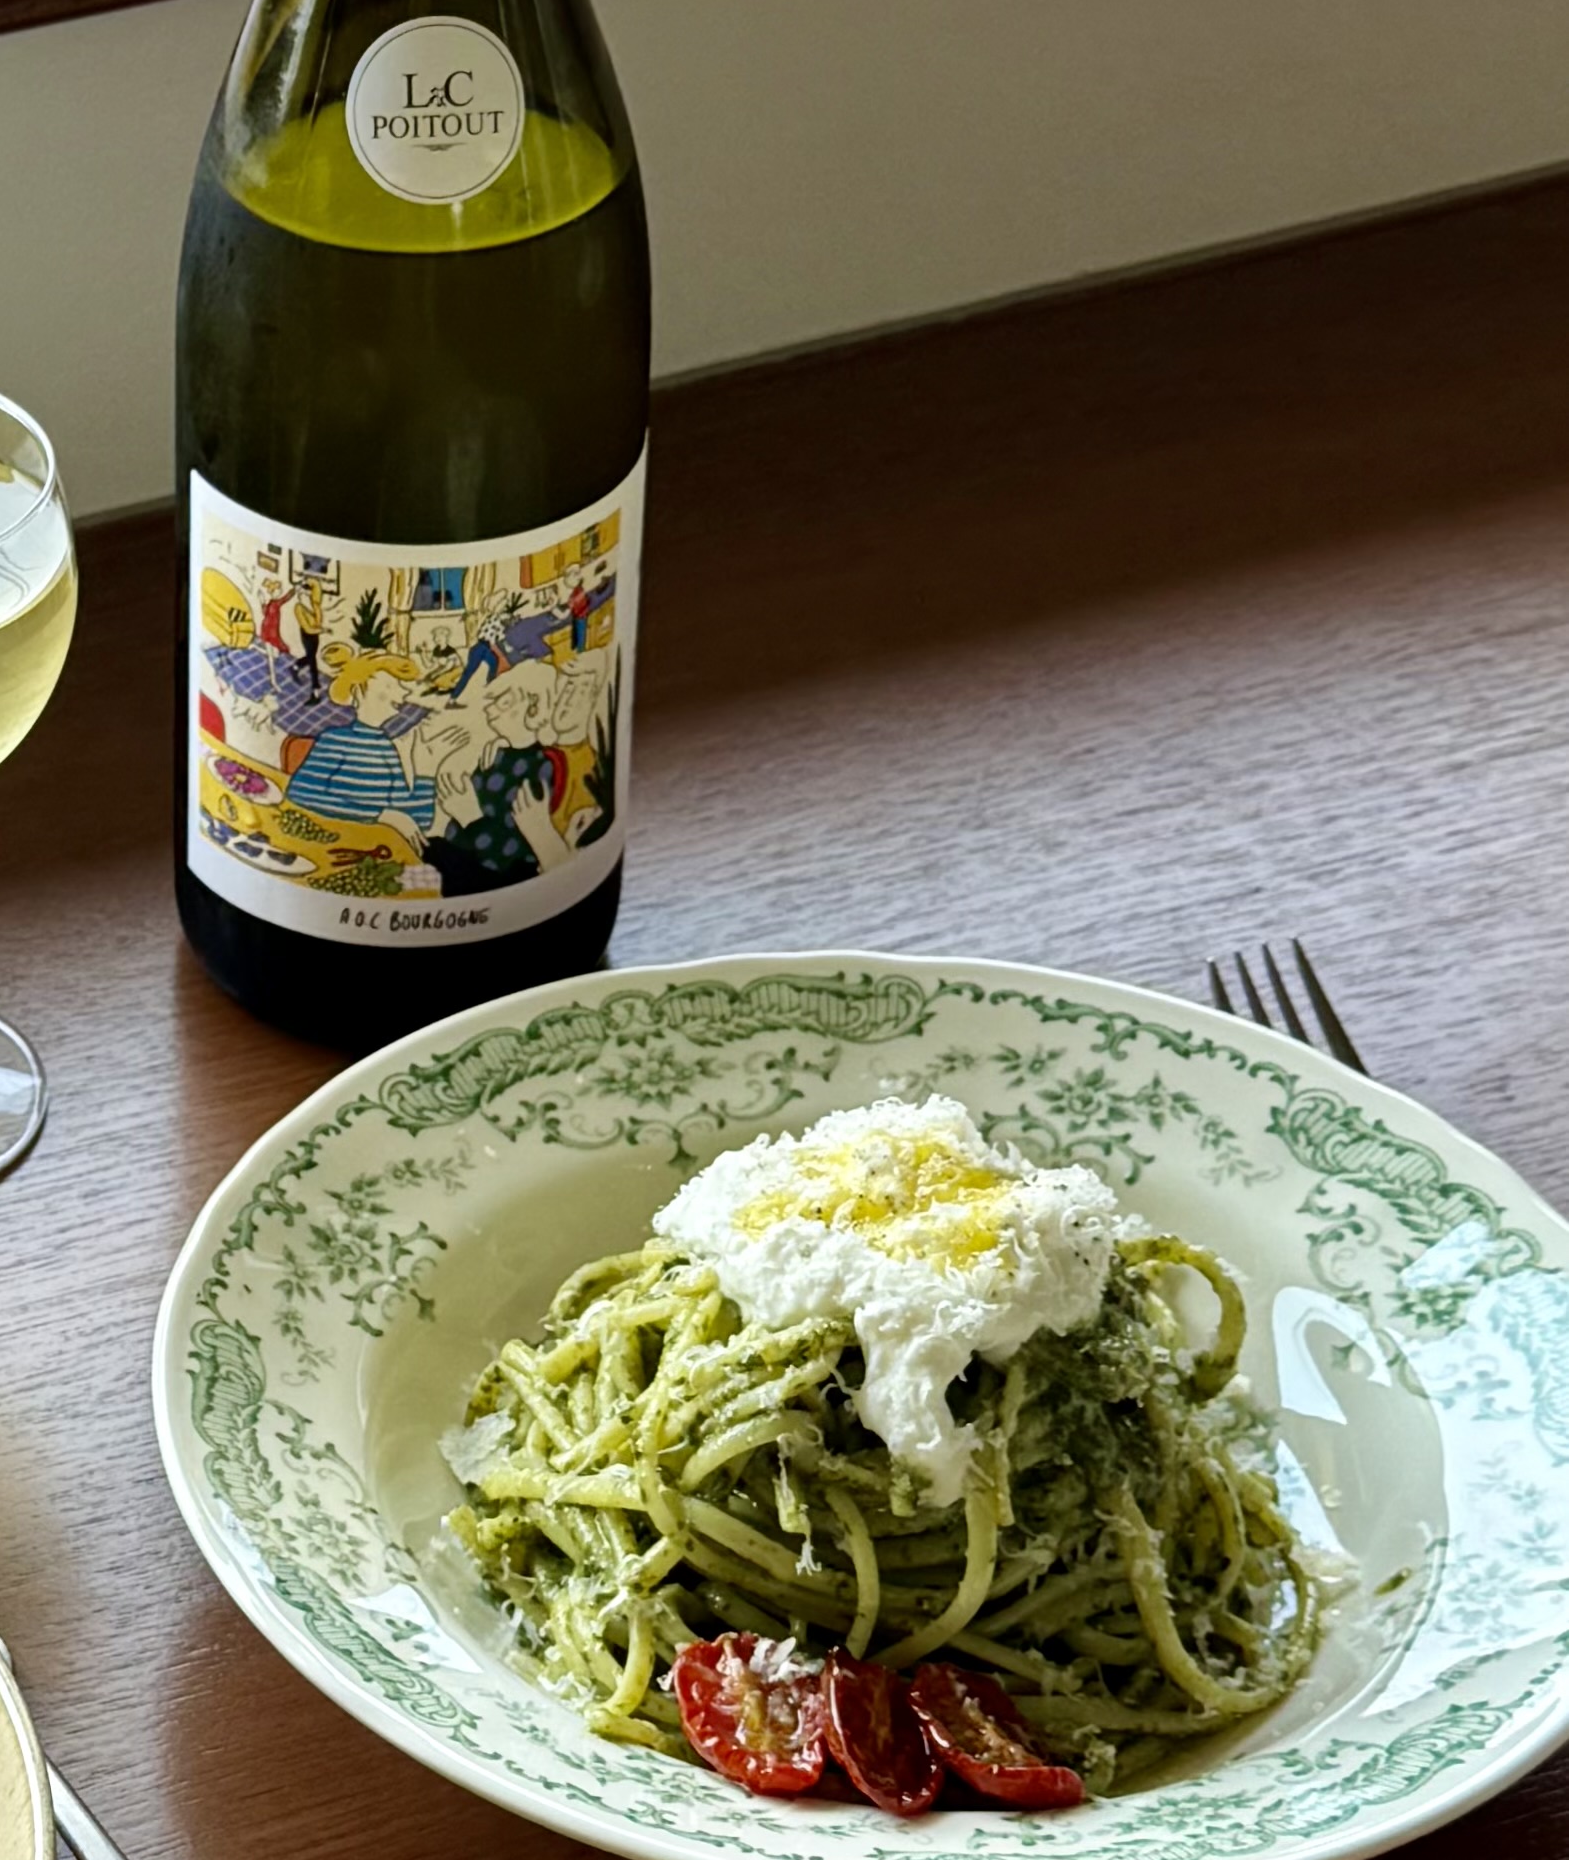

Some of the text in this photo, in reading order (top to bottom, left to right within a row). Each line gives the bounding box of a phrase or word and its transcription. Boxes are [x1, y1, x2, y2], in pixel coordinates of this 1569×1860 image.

[403, 71, 474, 108] L&C
[371, 111, 504, 139] POITOUT
[390, 907, 491, 931] BOURGOGNE
